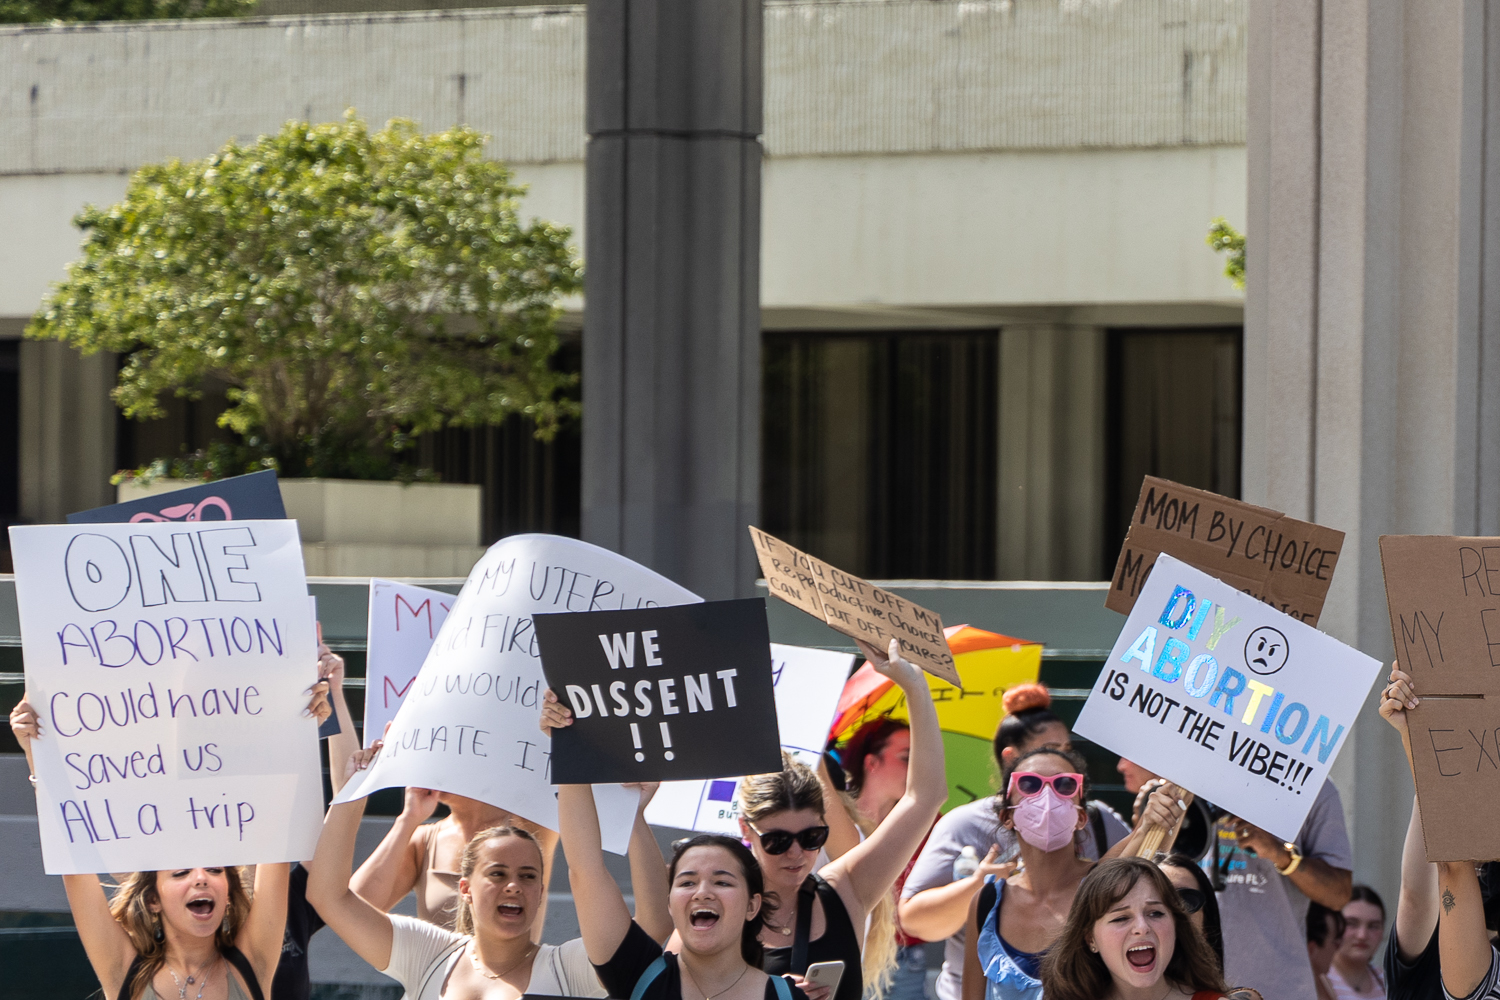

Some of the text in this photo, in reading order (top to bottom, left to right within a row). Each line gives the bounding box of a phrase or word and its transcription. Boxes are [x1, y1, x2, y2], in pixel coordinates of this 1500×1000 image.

[1139, 486, 1338, 580] MOM BY CHOICE
[65, 526, 262, 613] ONE
[530, 562, 659, 612] UTER
[757, 532, 941, 634] IF YOU CUT OFF MY
[395, 592, 452, 640] M
[811, 597, 818, 610] I
[857, 618, 886, 640] OFF
[1158, 583, 1243, 652] DIY
[1399, 610, 1445, 672] MY
[57, 616, 284, 669] ABORTION
[598, 629, 663, 670] WE
[169, 684, 264, 720] have
[564, 668, 738, 720] DISSENT
[1120, 625, 1345, 765] ABORTION
[183, 743, 223, 773] us
[385, 725, 491, 761] ULATE
[1101, 669, 1314, 795] IS NOT THE VIBE!!!
[60, 793, 256, 844] ALL a trip
